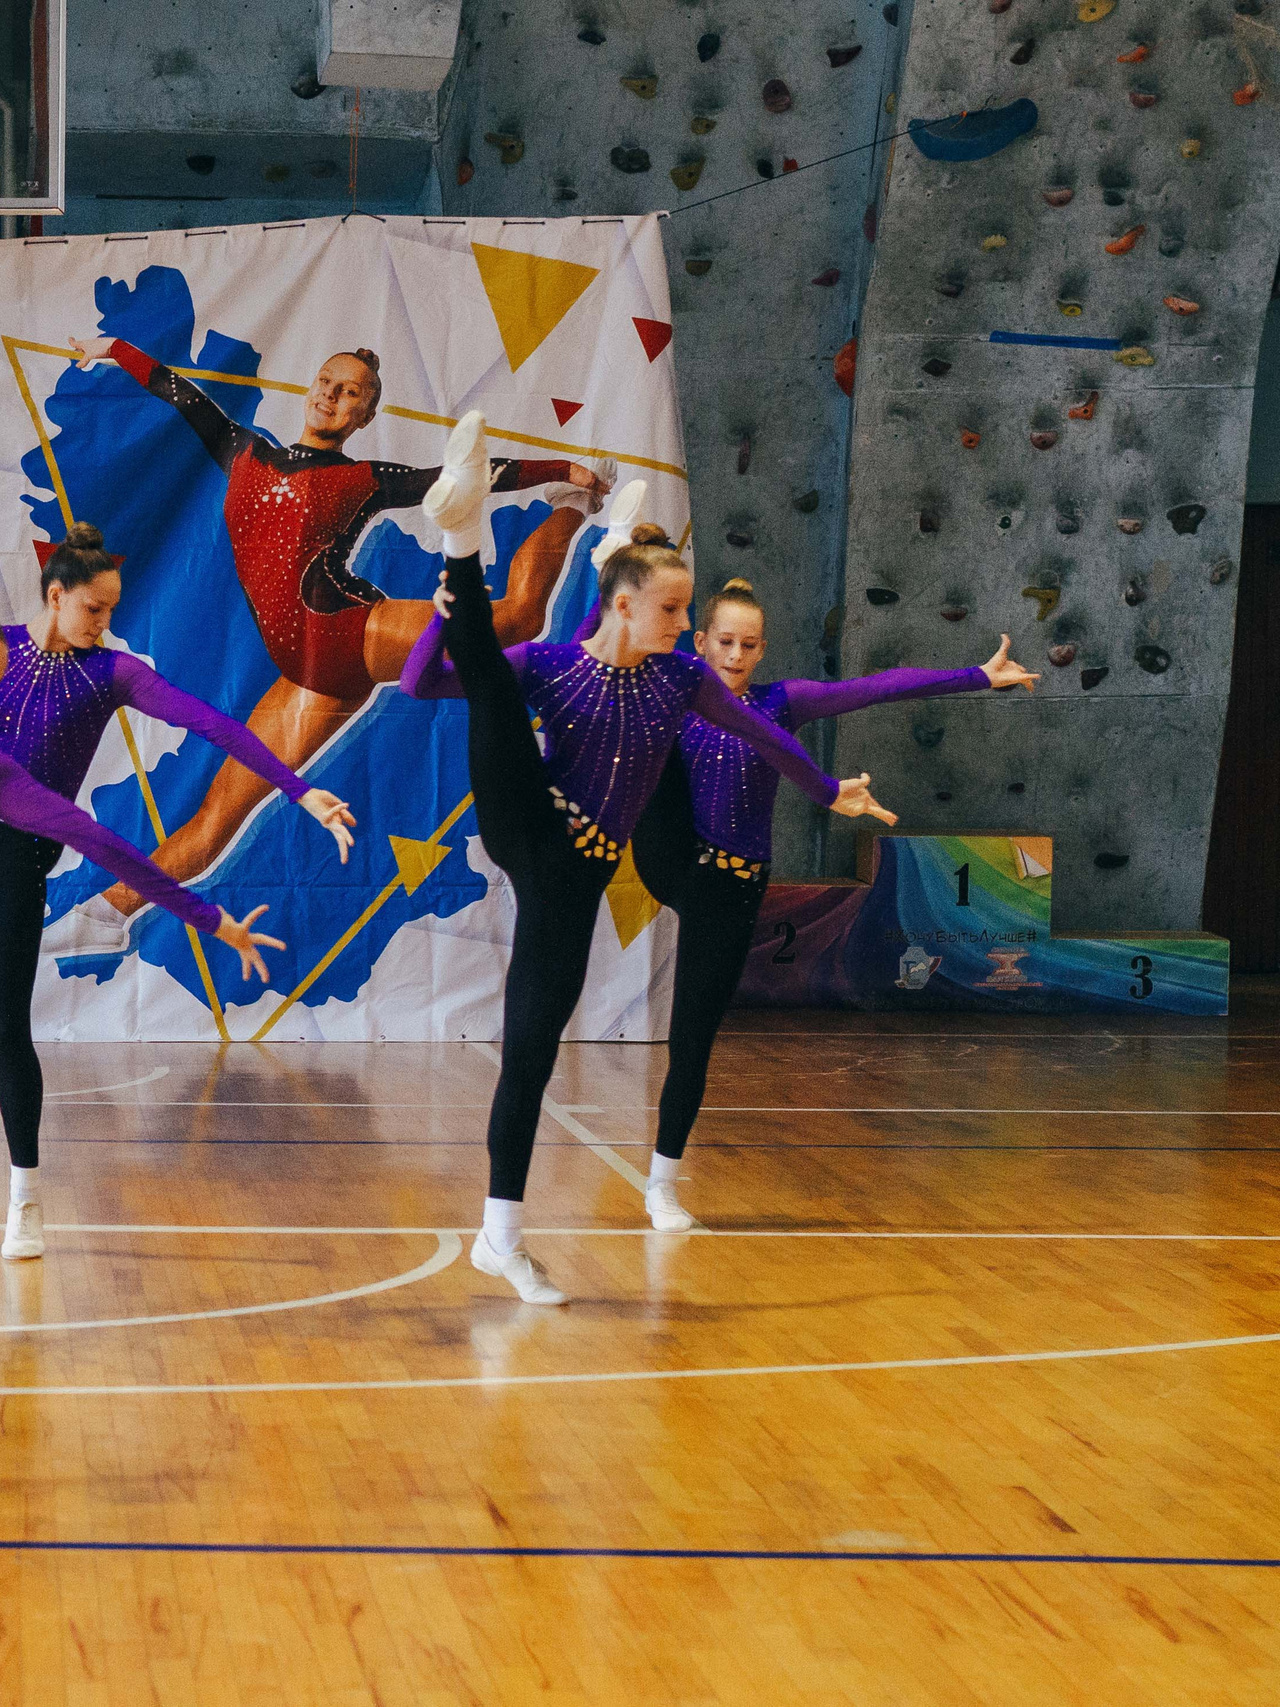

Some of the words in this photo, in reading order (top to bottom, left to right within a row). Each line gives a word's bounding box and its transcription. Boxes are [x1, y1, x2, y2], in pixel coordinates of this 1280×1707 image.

[954, 862, 971, 907] 1
[771, 921, 798, 965] 2
[1129, 955, 1154, 1000] 3
